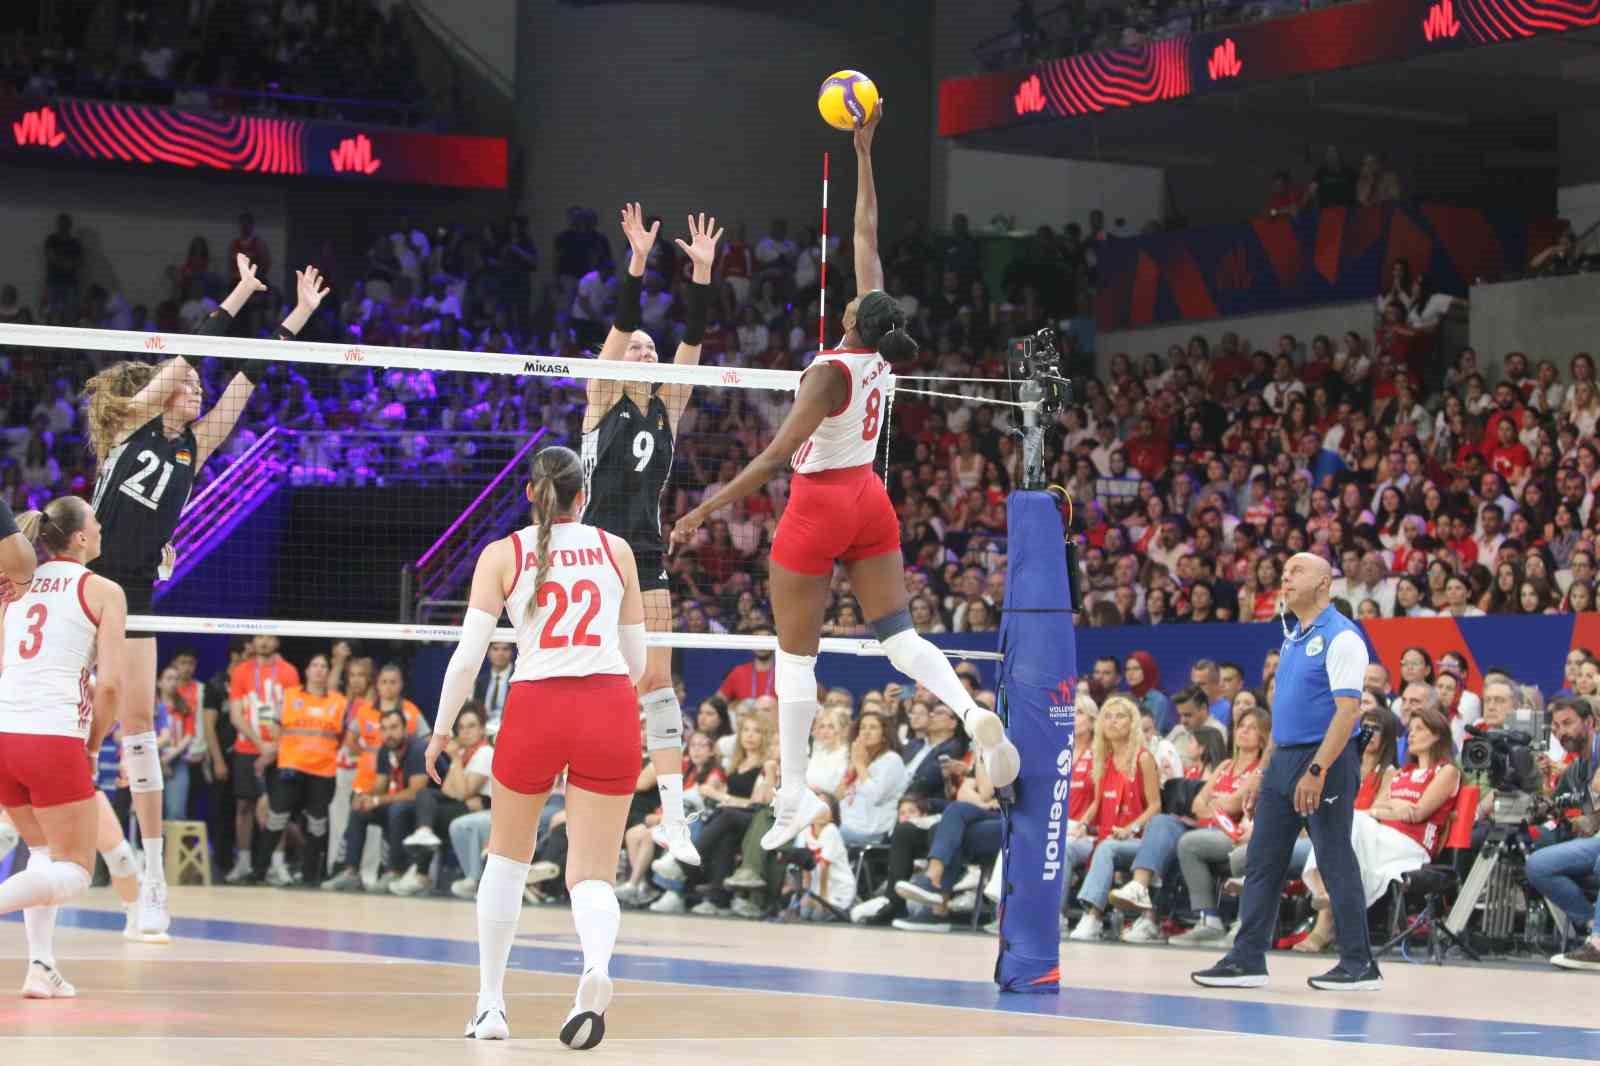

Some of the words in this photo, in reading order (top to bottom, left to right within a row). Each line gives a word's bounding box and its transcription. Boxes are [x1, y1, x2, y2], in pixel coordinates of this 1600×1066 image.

[144, 336, 166, 350] VNL
[862, 388, 881, 441] 8
[632, 431, 655, 472] 9
[122, 449, 175, 502] 21
[524, 547, 604, 571] AYDIN
[31, 577, 73, 593] ZBAY
[18, 603, 48, 660] 3
[536, 579, 601, 649] 22
[1049, 705, 1076, 713] VOLLEYB
